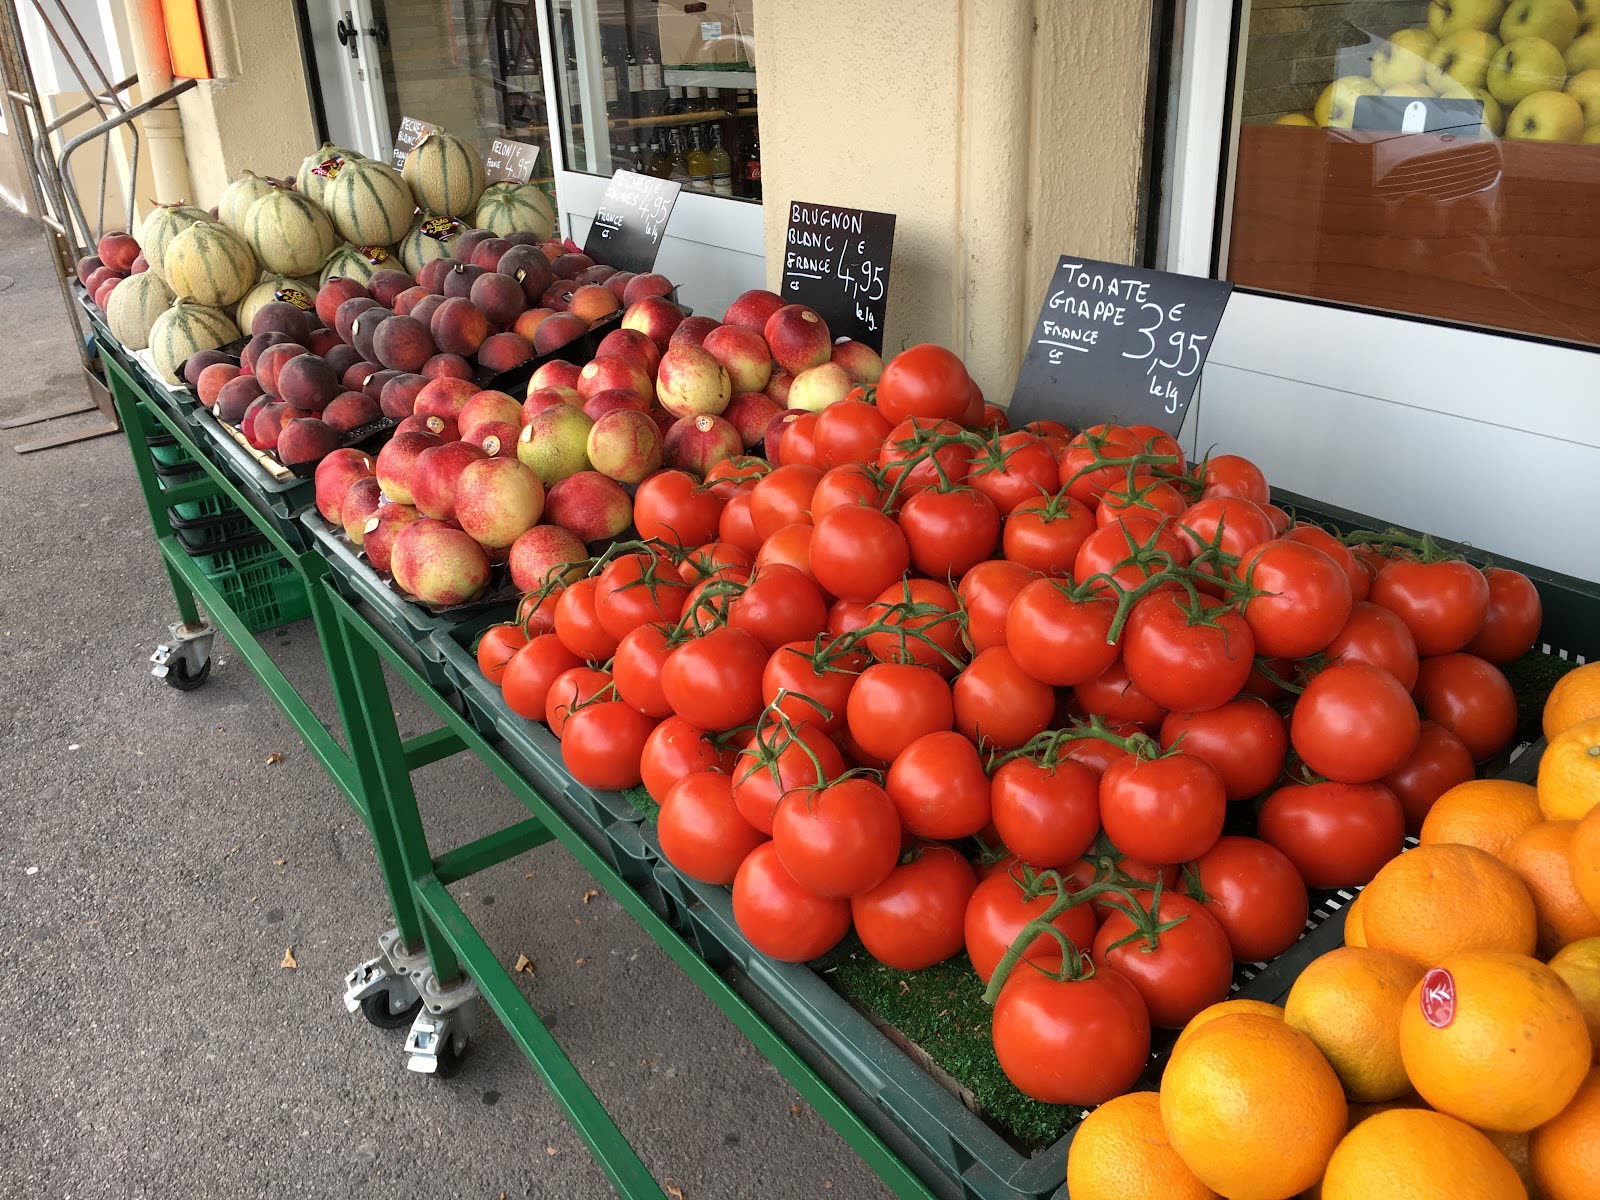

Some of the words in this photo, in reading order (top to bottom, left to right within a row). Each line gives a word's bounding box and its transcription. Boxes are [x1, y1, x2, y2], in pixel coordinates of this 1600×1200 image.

[597, 206, 624, 226] FRANCE
[639, 184, 671, 224] 4,95
[792, 204, 863, 234] BRUGNON
[788, 228, 834, 252] BLANC
[787, 252, 831, 274] FRANCE
[837, 239, 884, 300] 4,95
[1063, 264, 1150, 303] TOMATE
[1049, 290, 1126, 326] GRAPPE
[1168, 303, 1186, 322] €
[1043, 320, 1099, 345] FRANCE
[1122, 302, 1208, 377] 3,95
